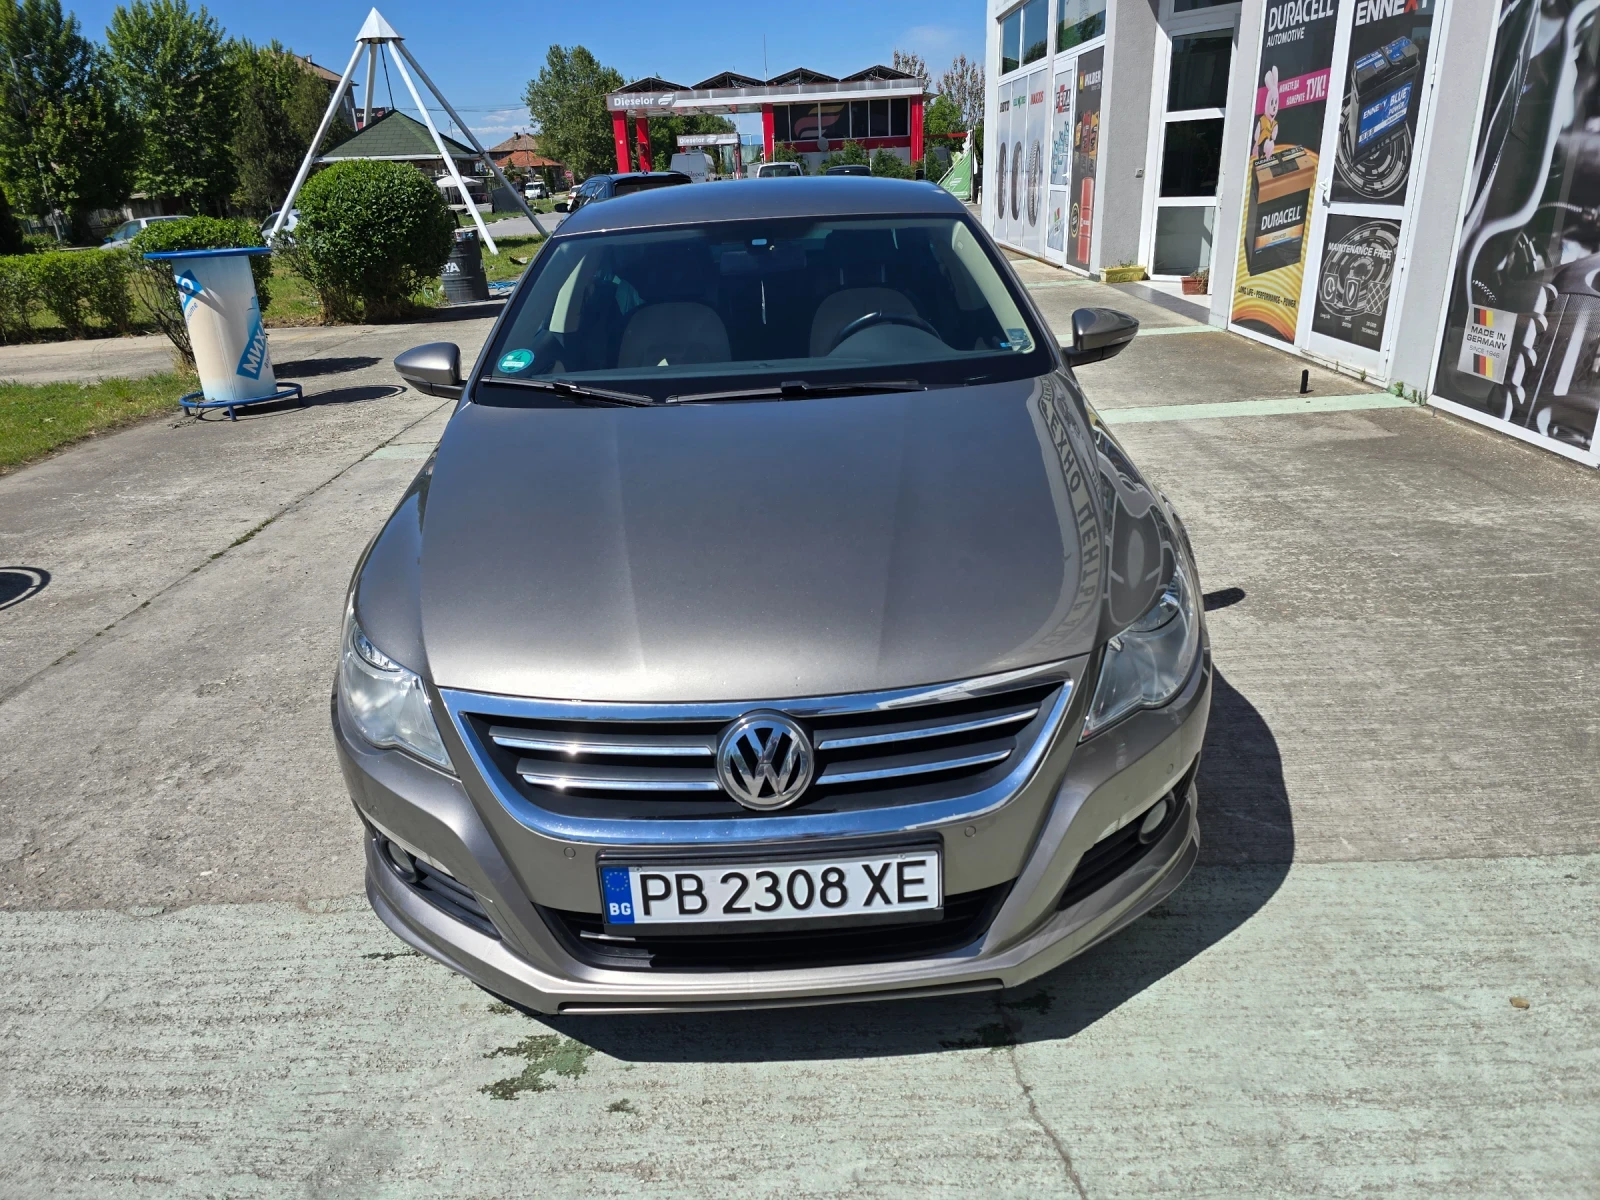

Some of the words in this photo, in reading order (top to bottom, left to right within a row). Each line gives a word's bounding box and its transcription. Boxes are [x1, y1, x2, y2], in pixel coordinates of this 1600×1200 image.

[1268, 0, 1334, 32] DURACELL
[1267, 27, 1305, 47] AUTOMOTIVE
[1306, 74, 1327, 100] ТУК!
[614, 97, 654, 106] Dieselor
[1390, 88, 1407, 106] BLUE
[1261, 206, 1301, 230] DURACELL
[1328, 242, 1373, 256] MAINTENANCE
[1373, 248, 1392, 258] FREE
[1466, 333, 1507, 350] GERMANY
[1470, 325, 1495, 338] MADE
[1497, 332, 1506, 341] IN
[1469, 345, 1485, 354] SINCE
[640, 873, 708, 916] PB
[720, 866, 848, 915] 2308
[861, 860, 929, 907] XE
[609, 903, 631, 917] BG
